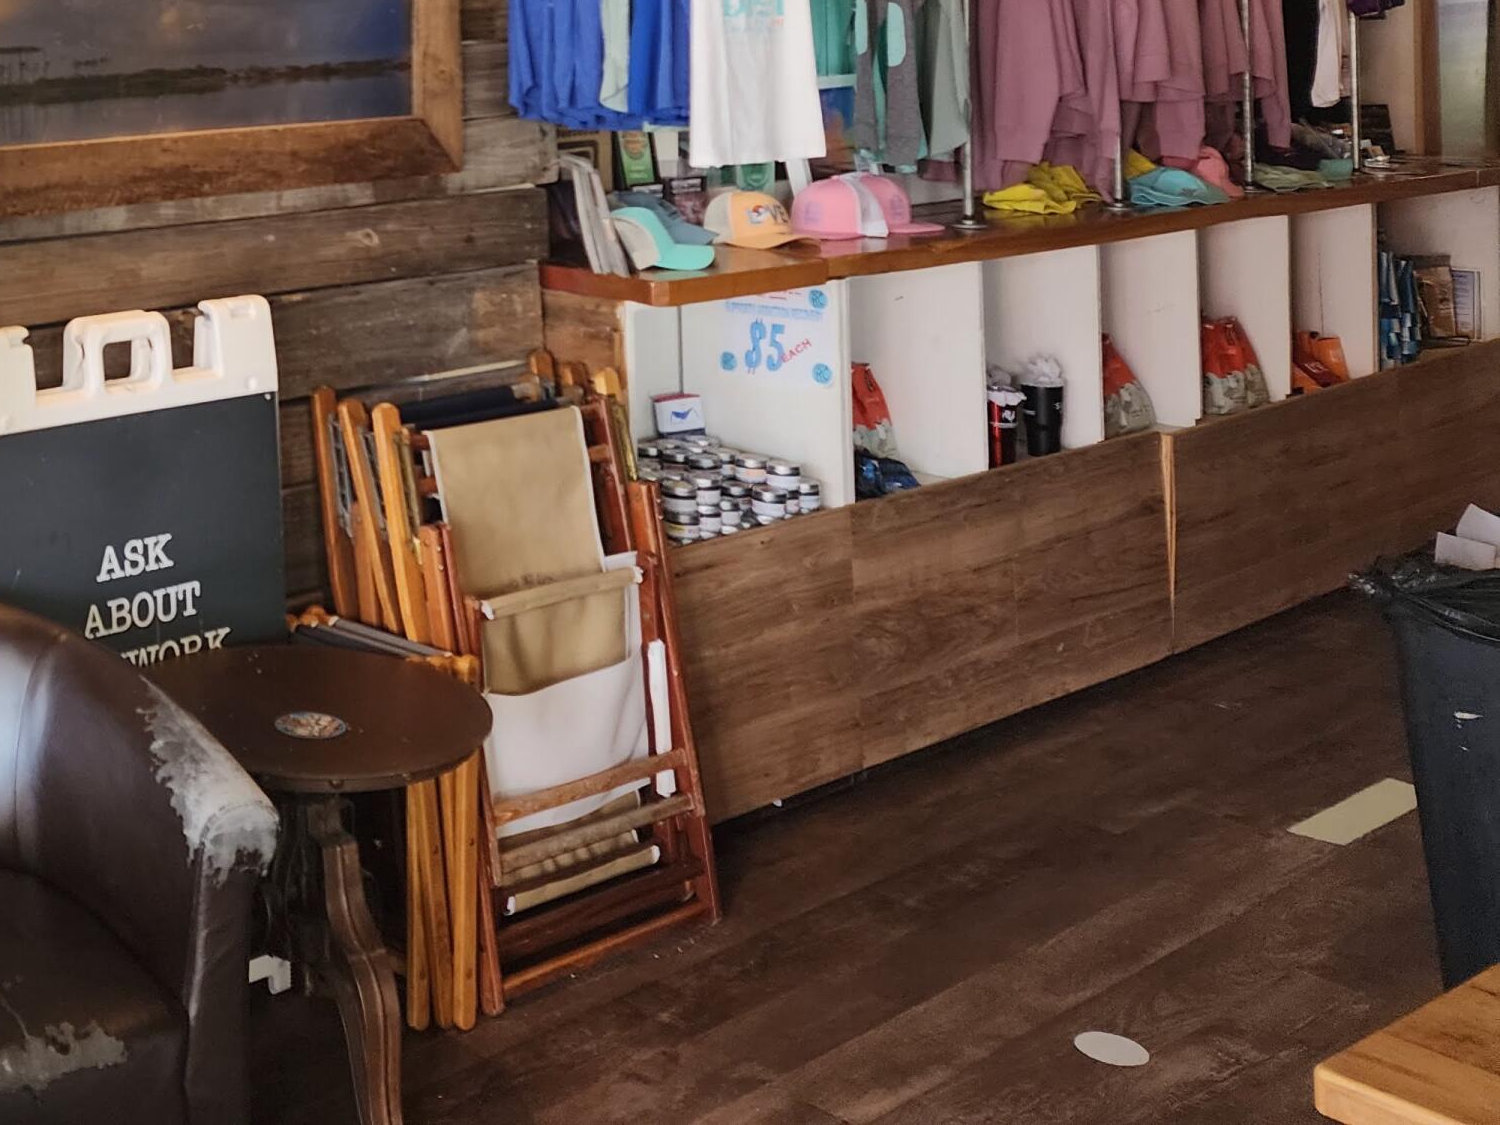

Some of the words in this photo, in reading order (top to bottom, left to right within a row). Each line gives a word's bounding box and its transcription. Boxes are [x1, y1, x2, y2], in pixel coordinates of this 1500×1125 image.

[744, 318, 786, 374] $5
[96, 532, 175, 583] ASK
[83, 580, 202, 641] ABOUT
